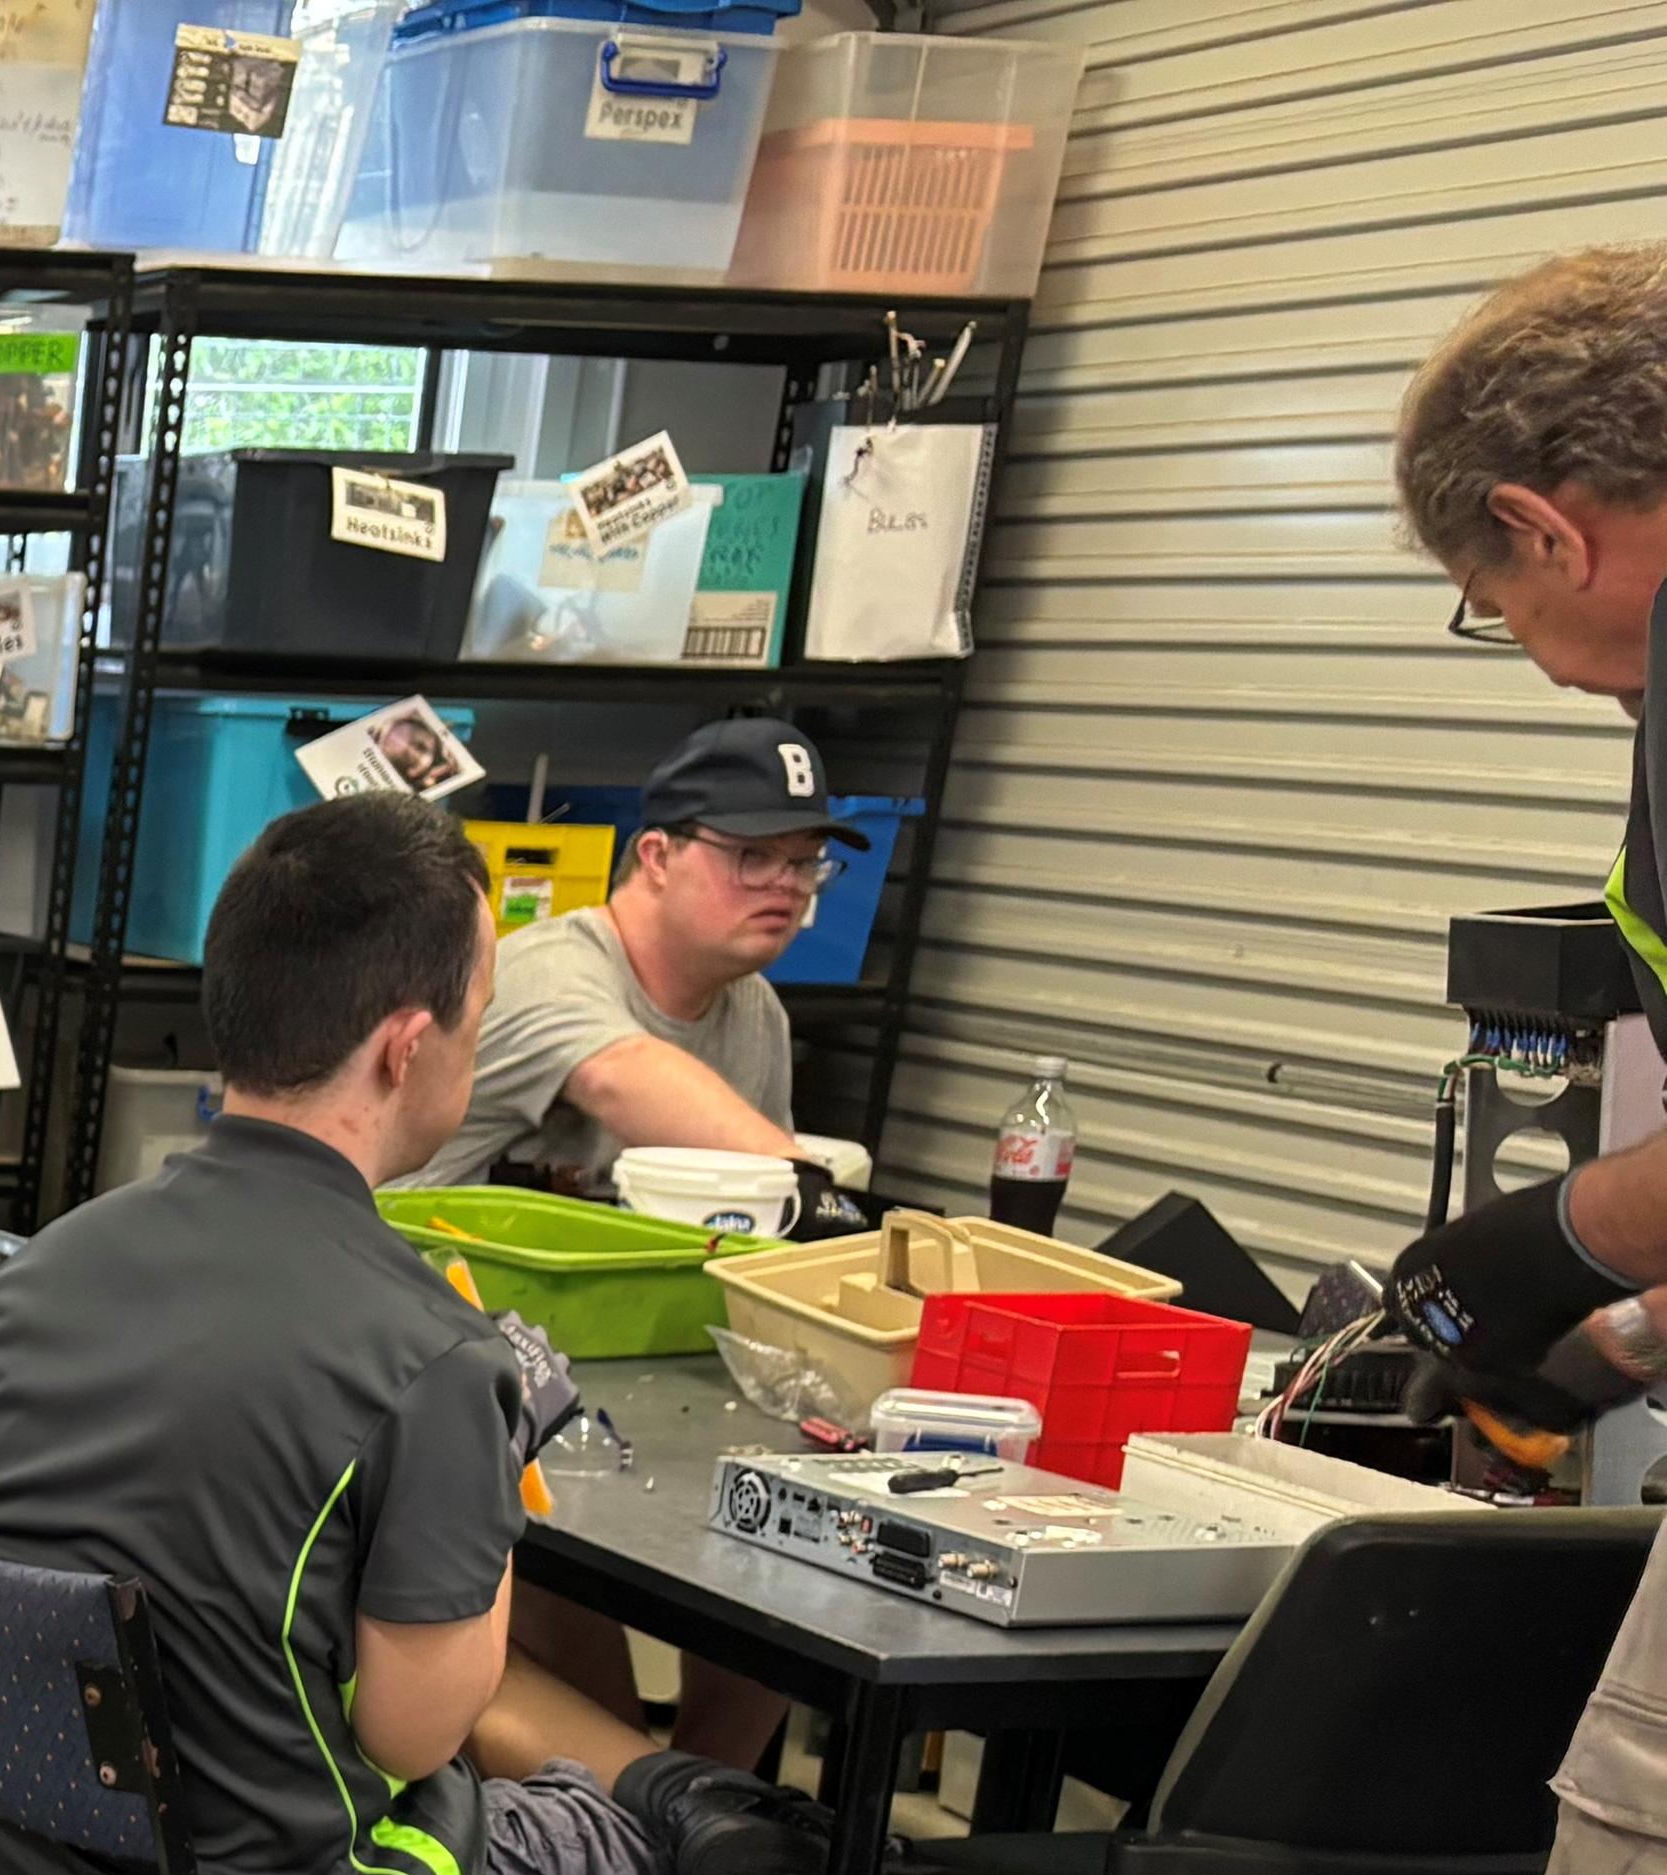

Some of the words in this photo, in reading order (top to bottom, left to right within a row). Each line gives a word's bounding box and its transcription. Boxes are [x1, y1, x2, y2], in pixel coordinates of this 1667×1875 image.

[599, 100, 682, 131] Perspex
[347, 516, 431, 549] Heatsinks
[778, 743, 815, 797] B
